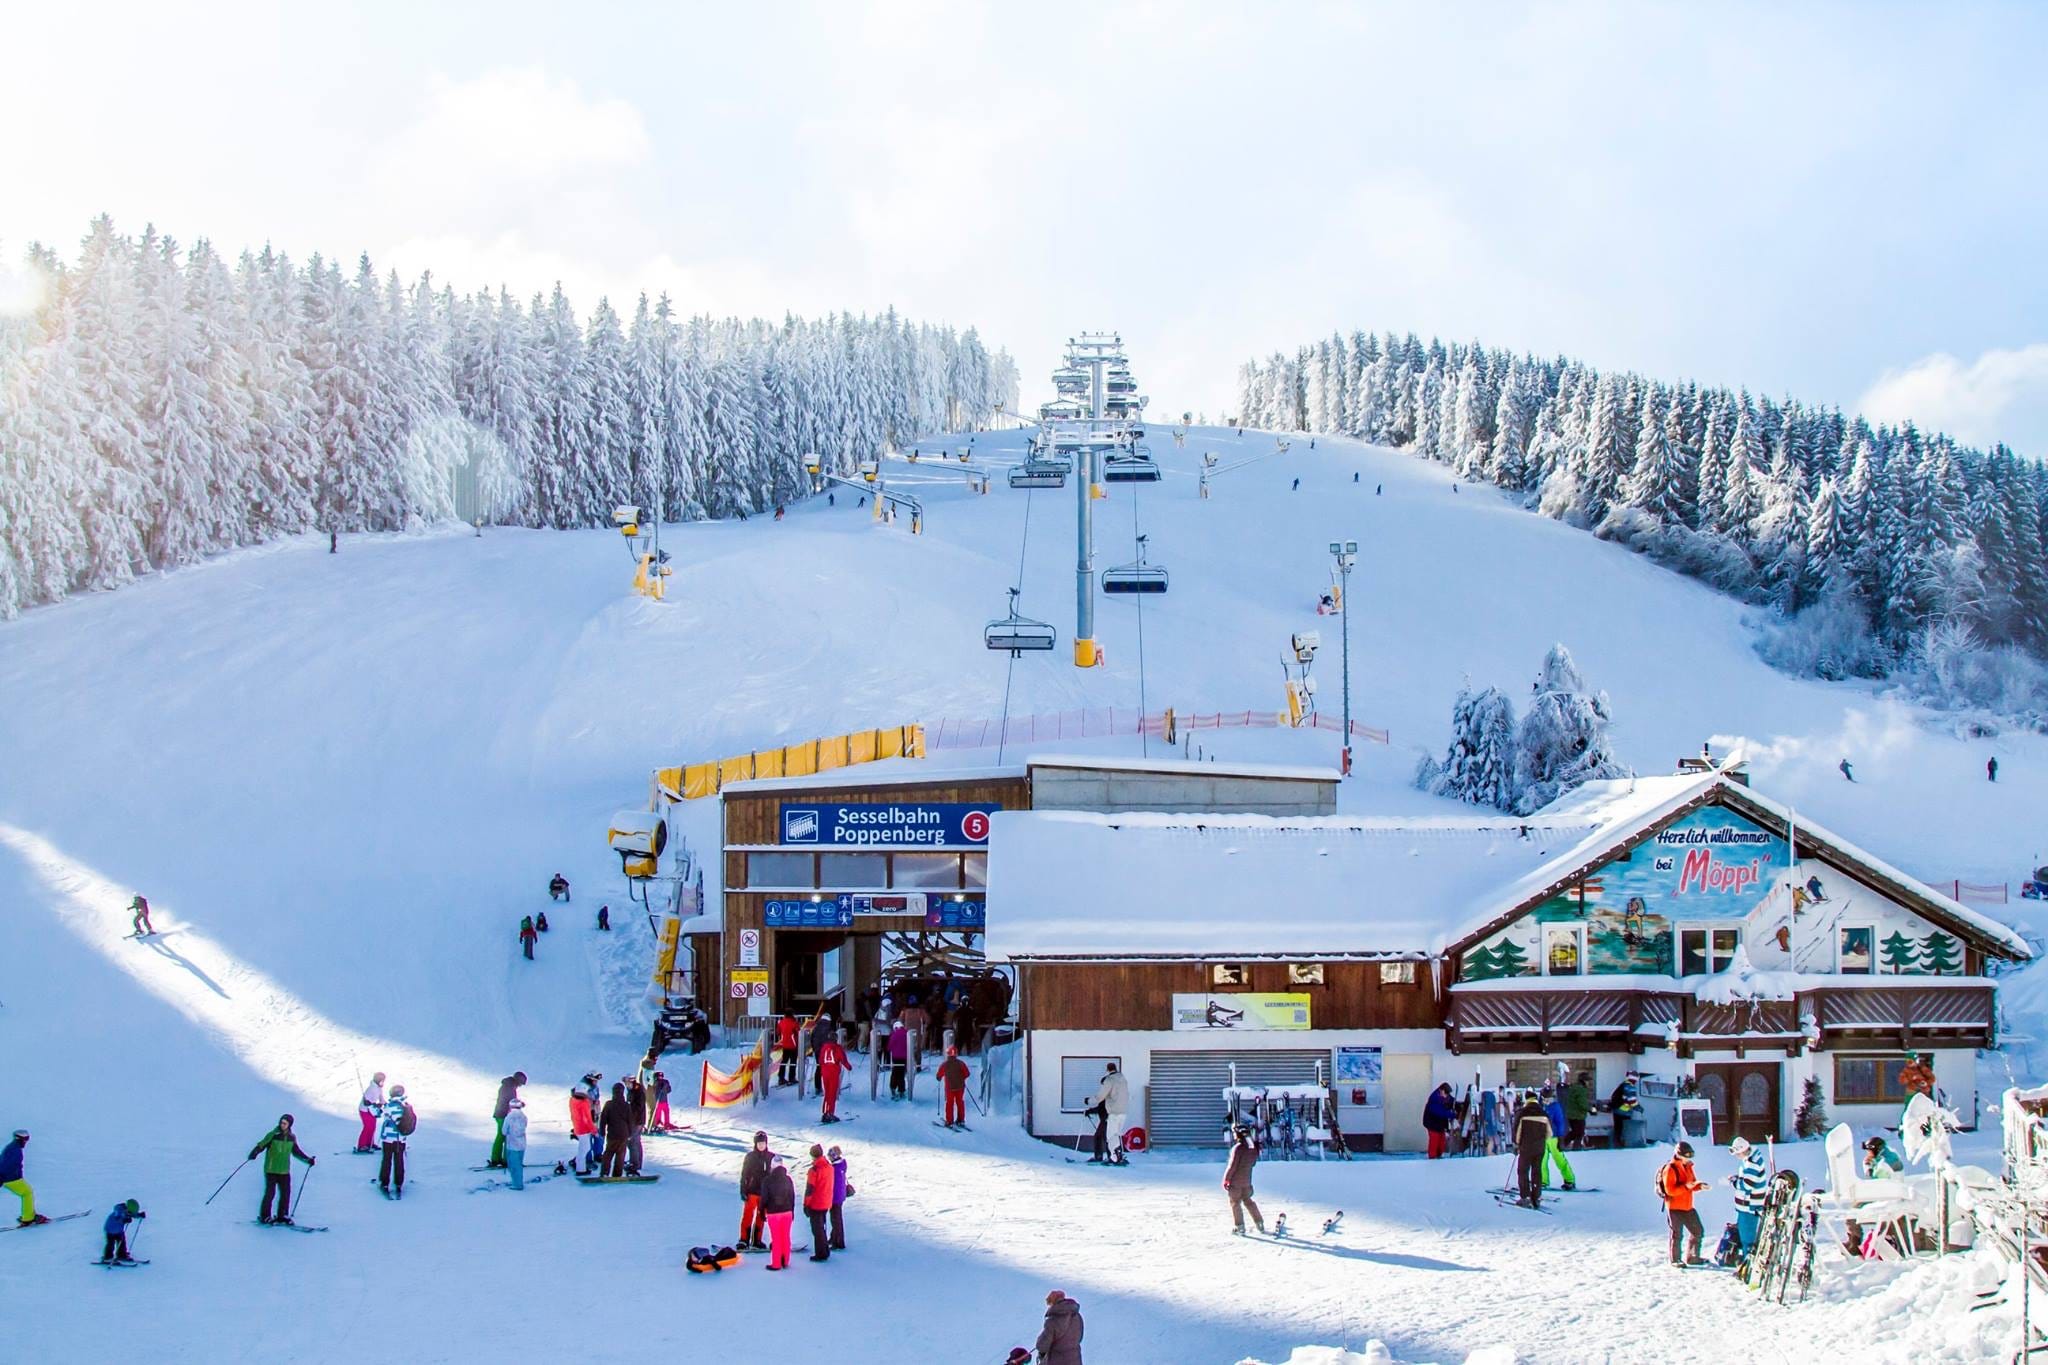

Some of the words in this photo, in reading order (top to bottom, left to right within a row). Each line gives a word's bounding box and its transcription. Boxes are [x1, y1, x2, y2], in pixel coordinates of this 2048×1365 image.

[838, 808, 940, 824] Sesselbahn
[972, 819, 982, 832] 5
[834, 826, 945, 844] Poppenberg
[1657, 828, 1708, 844] Herzlich
[1710, 828, 1770, 844] willkommen
[1655, 858, 1673, 870] bei
